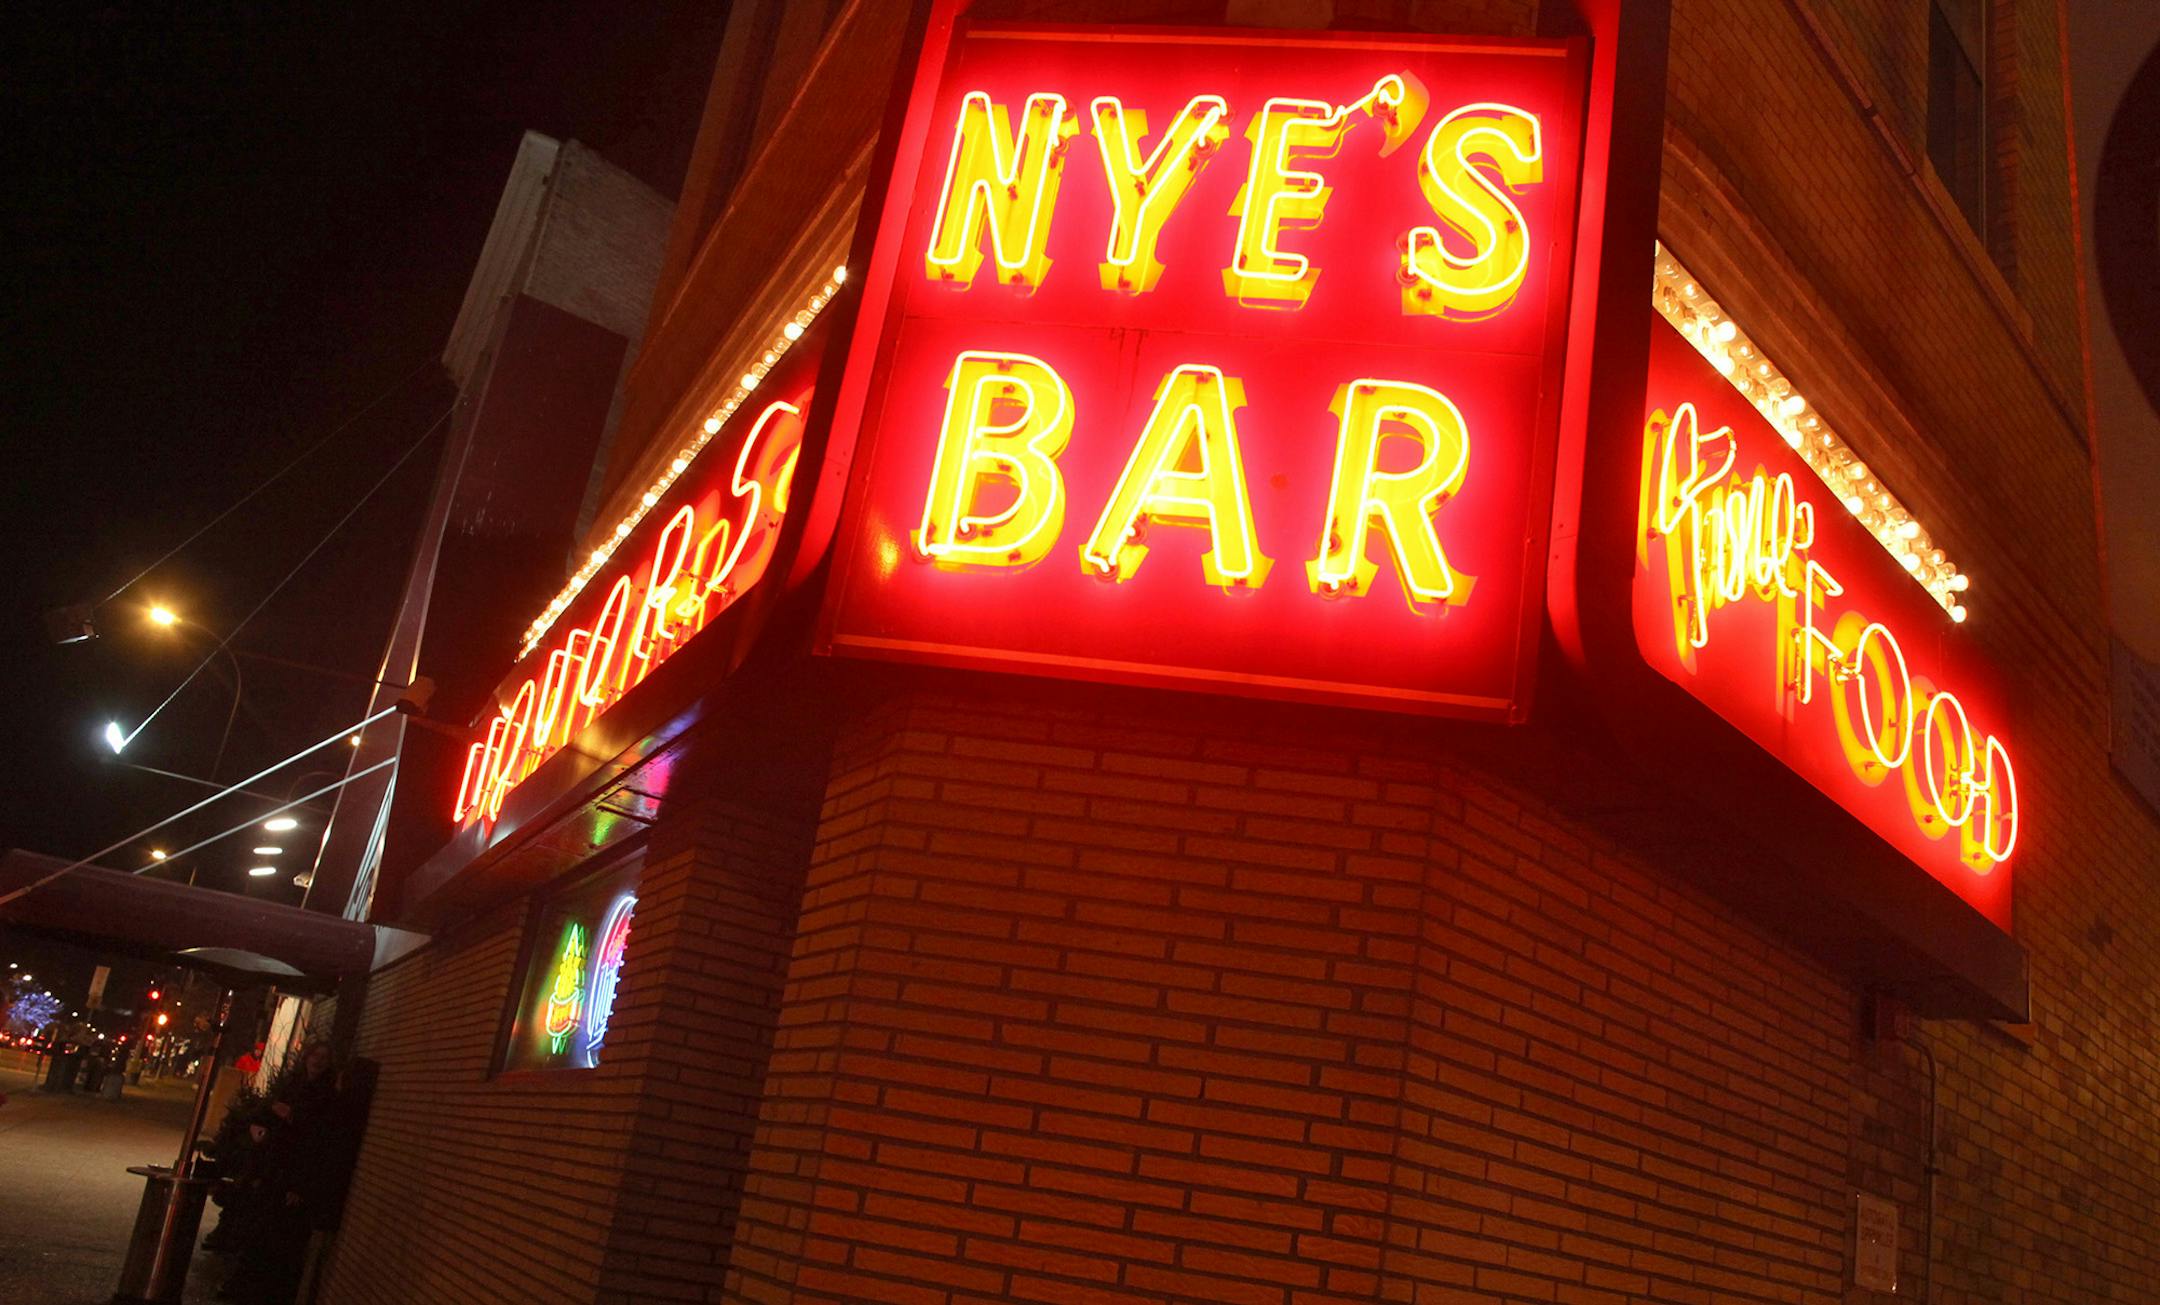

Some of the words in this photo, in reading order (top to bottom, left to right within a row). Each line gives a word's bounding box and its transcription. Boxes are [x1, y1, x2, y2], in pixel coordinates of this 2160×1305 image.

[924, 70, 1544, 322] NYE'S
[453, 398, 808, 830] LIQUORS
[910, 350, 1478, 618] BAR
[1778, 558, 2018, 874] FOOD
